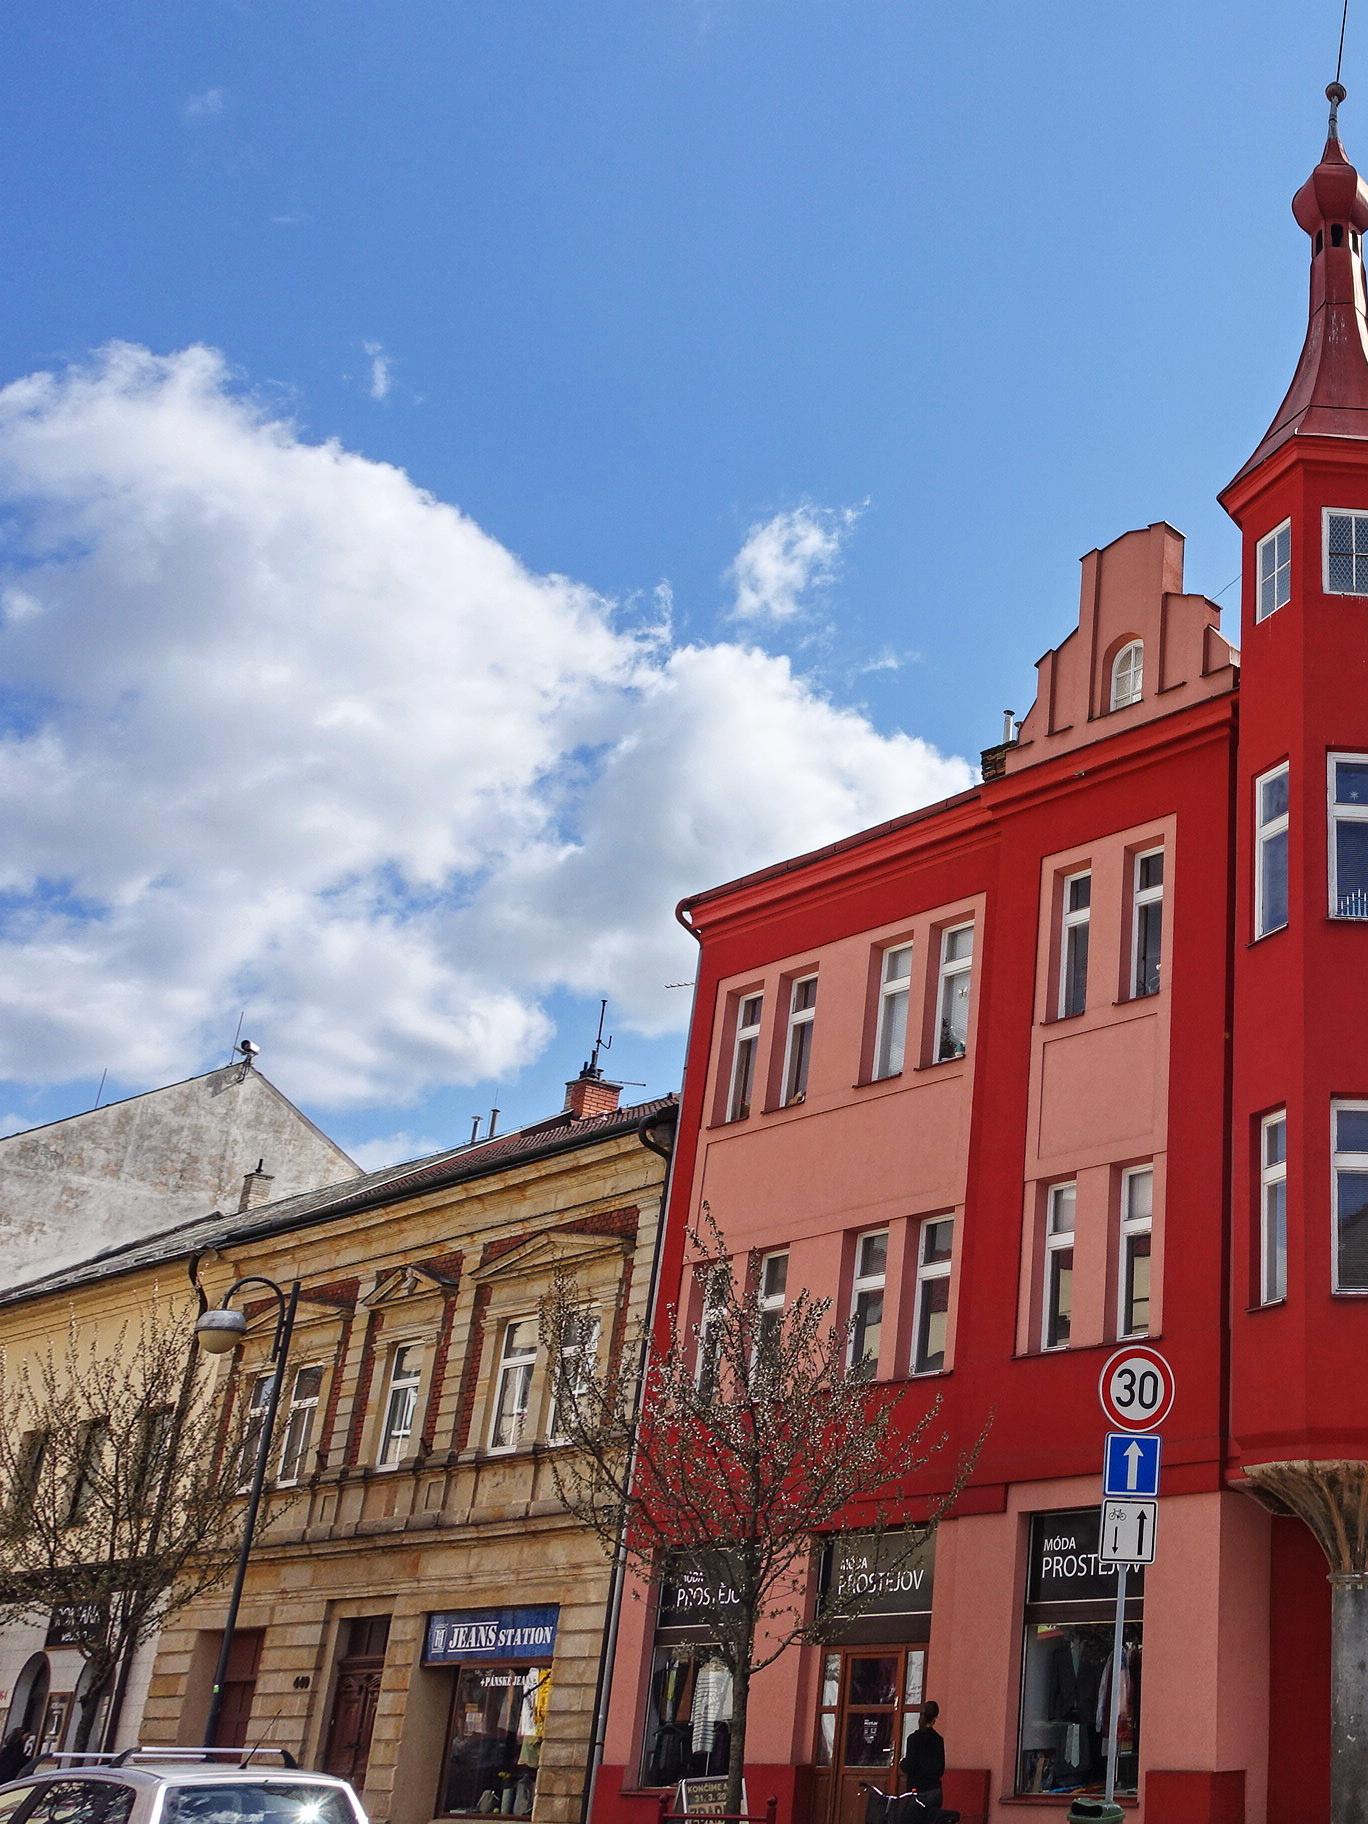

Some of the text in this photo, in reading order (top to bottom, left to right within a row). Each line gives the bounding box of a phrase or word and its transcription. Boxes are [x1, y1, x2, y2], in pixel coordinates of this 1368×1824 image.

[1115, 1368, 1159, 1410] 30
[1043, 1535, 1076, 1552] MÓDA
[1042, 1553, 1141, 1578] PROST
[448, 1625, 554, 1649] JEANS STATION
